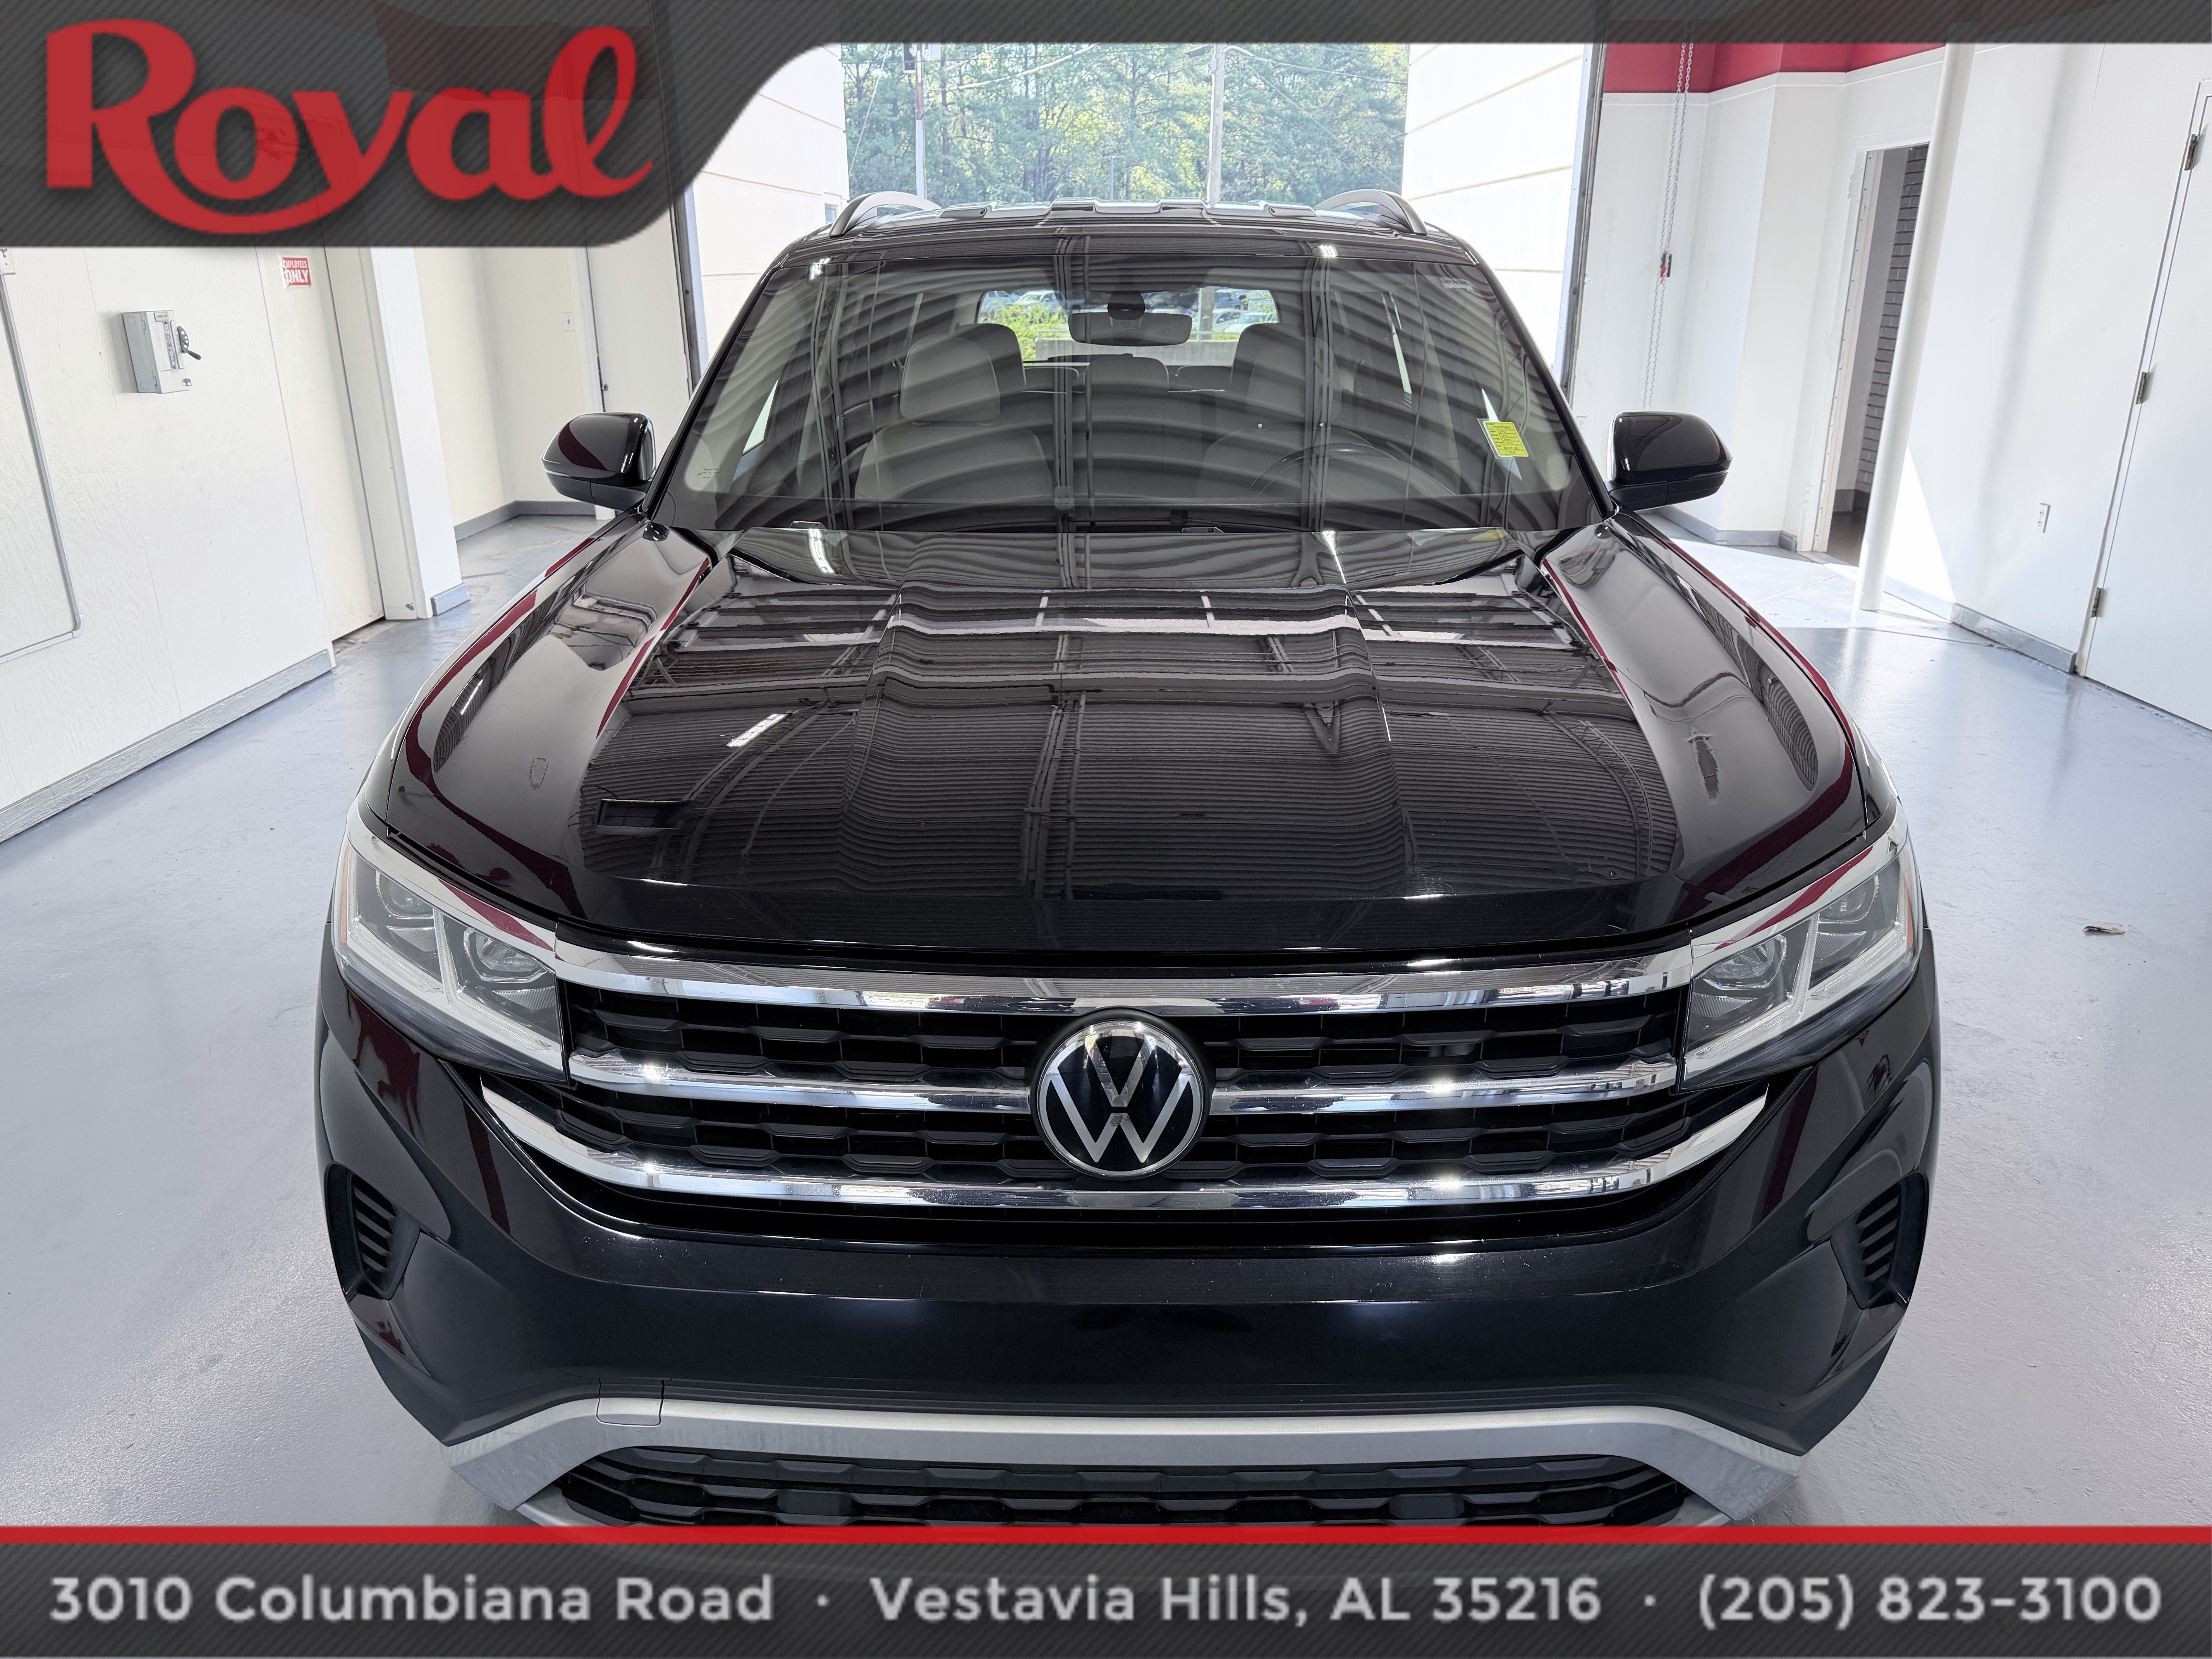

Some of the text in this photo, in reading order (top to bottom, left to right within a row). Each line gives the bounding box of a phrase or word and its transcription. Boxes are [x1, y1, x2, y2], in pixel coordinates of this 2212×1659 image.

[282, 260, 307, 268] EMPLOYEES
[284, 269, 309, 283] ONLY
[1044, 1028, 1197, 1166] VW
